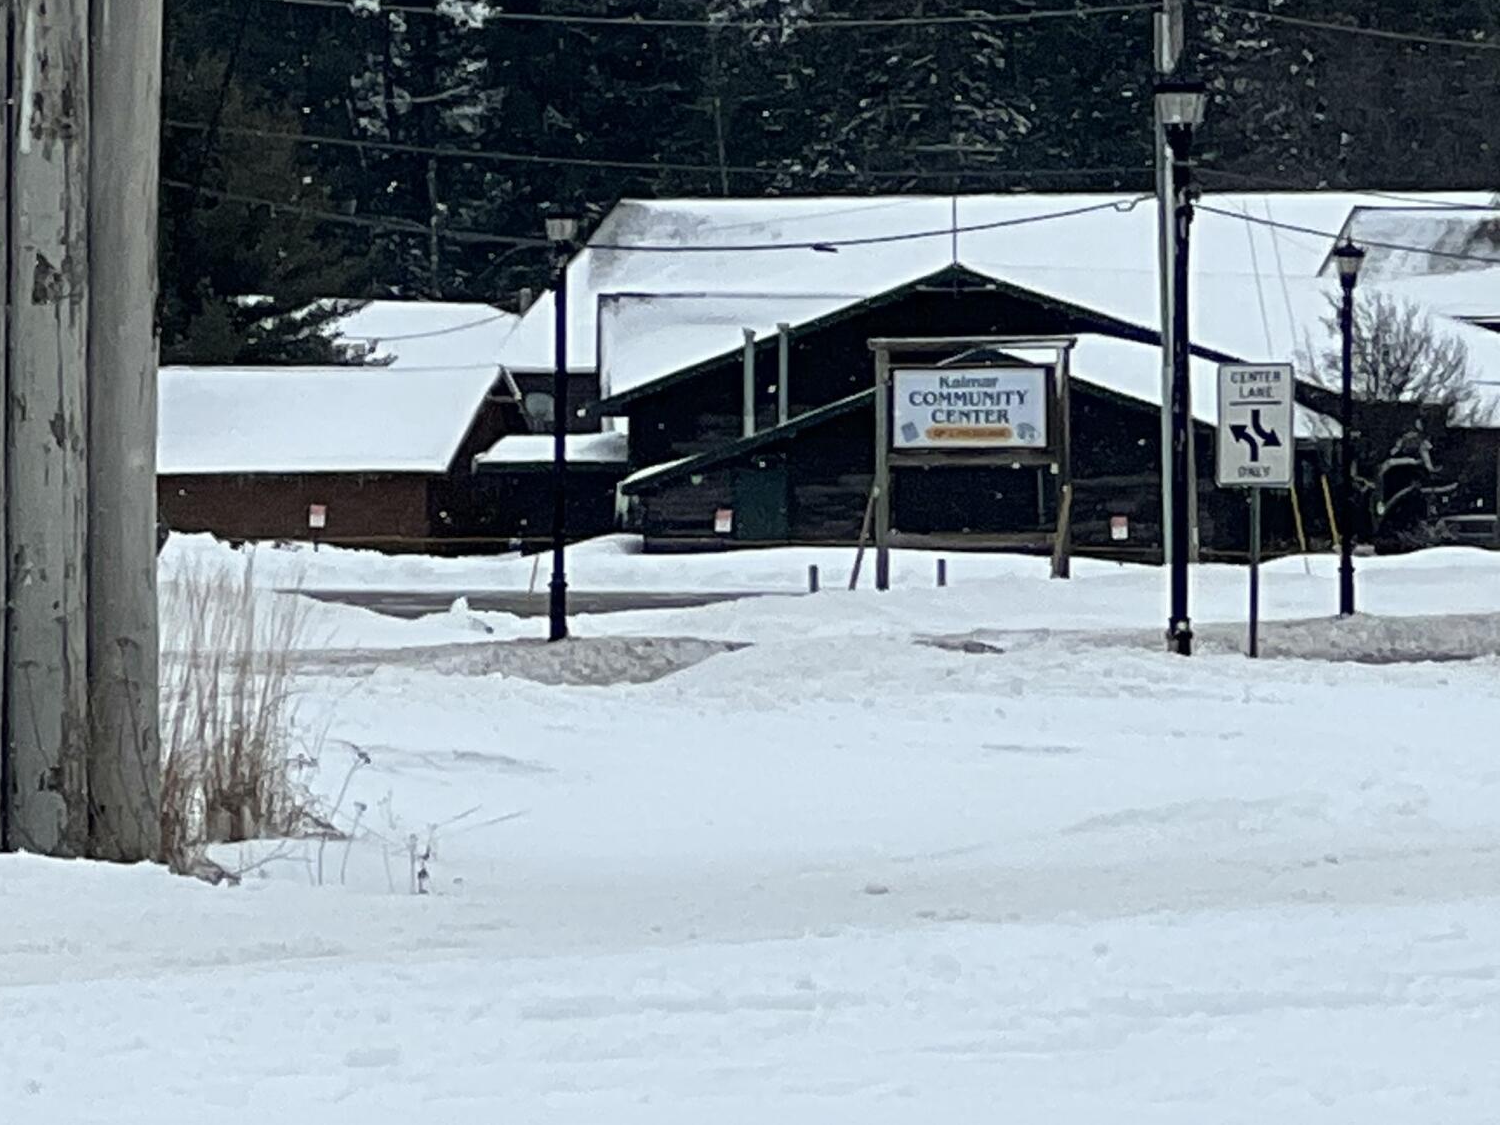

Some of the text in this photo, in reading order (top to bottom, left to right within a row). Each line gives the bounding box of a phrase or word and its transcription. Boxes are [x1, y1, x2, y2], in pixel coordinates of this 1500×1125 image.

[1231, 370, 1281, 384] CENTER
[908, 390, 1030, 407] COMMUNITY
[1239, 386, 1275, 399] LANE
[931, 408, 1010, 425] CENTER
[1238, 466, 1271, 478] ONLY
